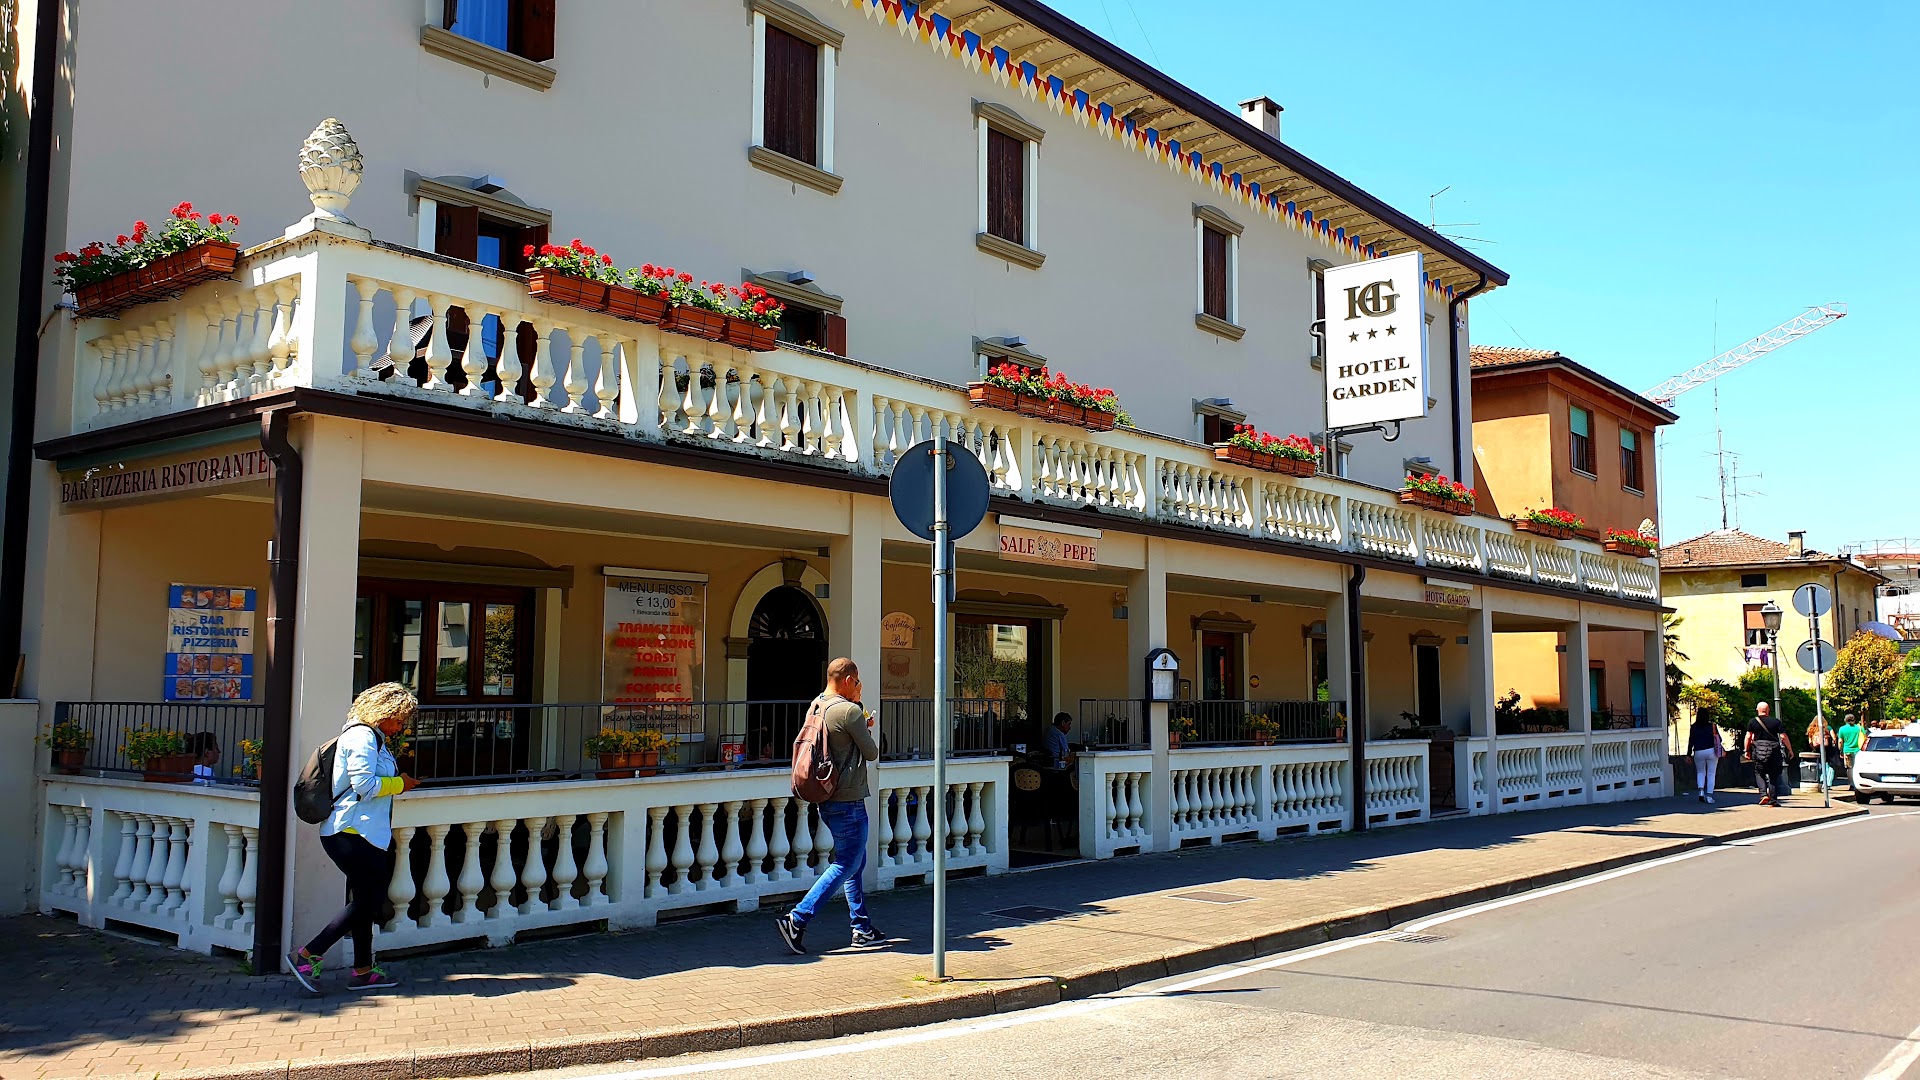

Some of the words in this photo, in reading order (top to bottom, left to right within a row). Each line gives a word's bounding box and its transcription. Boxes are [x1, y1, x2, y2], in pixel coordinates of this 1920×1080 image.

[1338, 356, 1410, 379] HOTEL
[1333, 376, 1417, 401] GARDEN
[62, 479, 89, 503] BAR
[91, 468, 157, 499] PIZZERIA
[161, 449, 268, 489] RISTORANTE
[1000, 535, 1035, 555] SALE
[1063, 543, 1096, 562] PEPE
[619, 582, 654, 594] MENU
[658, 584, 693, 595] FISSO
[635, 596, 644, 607] €
[647, 596, 676, 609] 13,00
[1425, 591, 1446, 603] HOTEL
[199, 615, 224, 625] BAR
[173, 626, 249, 637] RISTORANTE
[618, 623, 693, 635] TRAMEZZINI
[183, 638, 238, 648] PIZZERIA
[890, 634, 908, 647] Bar
[636, 652, 677, 663] TOAST
[633, 667, 678, 677] PANINI
[626, 683, 682, 693] FOCACCE
